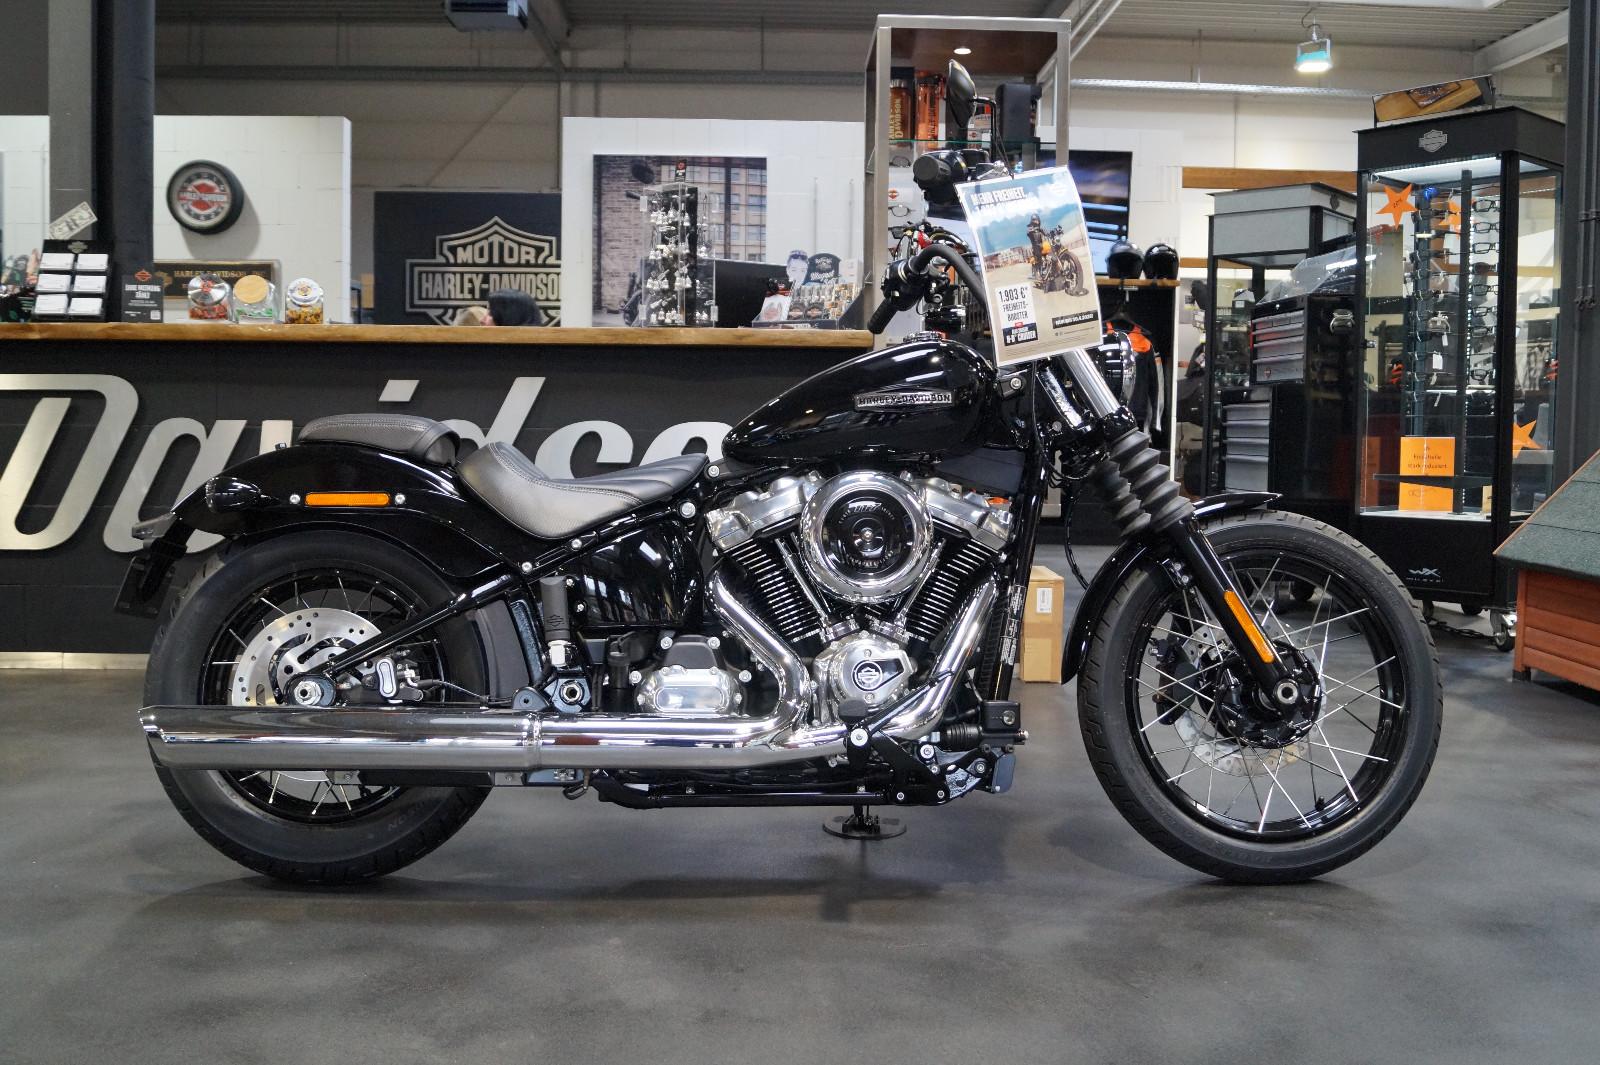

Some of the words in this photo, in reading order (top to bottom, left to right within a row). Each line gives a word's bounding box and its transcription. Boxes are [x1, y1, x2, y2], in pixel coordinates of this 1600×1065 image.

[456, 233, 536, 264] MOTOR
[421, 272, 561, 300] HARLEY-DAVIDSO
[858, 393, 952, 406] HARLEY-DAVIDSON
